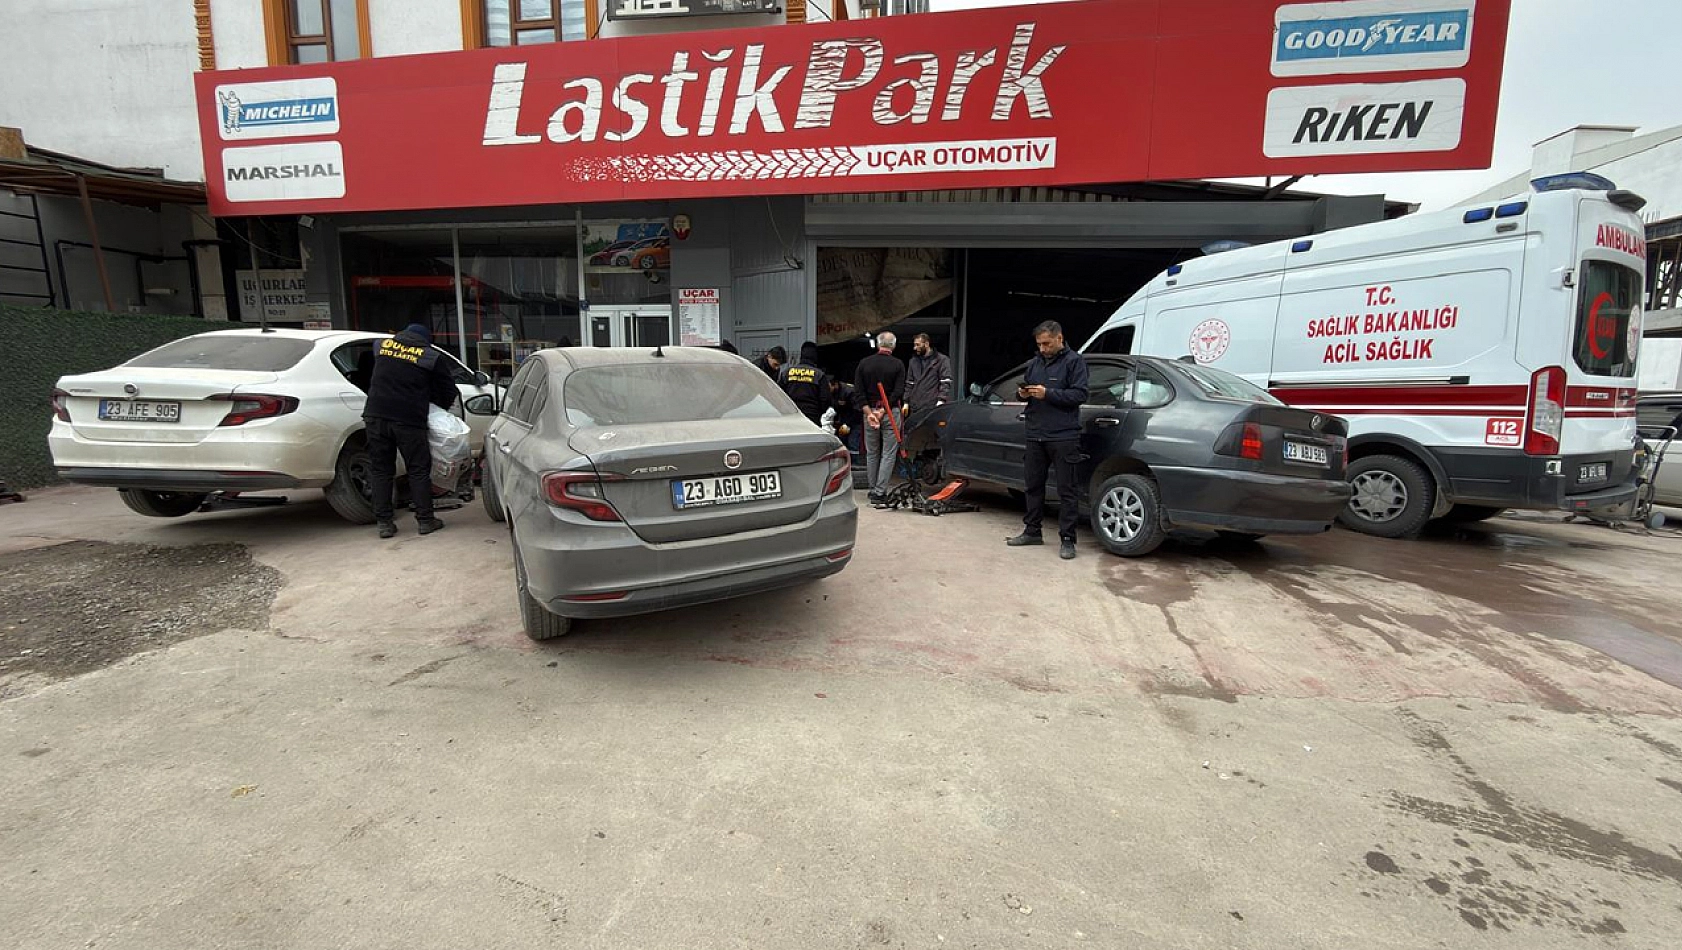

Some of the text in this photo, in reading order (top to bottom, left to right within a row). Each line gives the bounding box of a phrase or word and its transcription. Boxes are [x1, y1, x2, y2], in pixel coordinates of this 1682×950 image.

[245, 103, 331, 120] MICHELIN
[867, 140, 1050, 171] UÇAR OTOMOTİV
[227, 163, 341, 181] MARSHAL
[683, 289, 714, 298] UÇAR
[1365, 285, 1396, 306] T.C.
[1307, 305, 1459, 339] SAĞLIK BAKANLIĞI
[1322, 335, 1434, 364] ACİL SAĞLIK
[107, 403, 178, 418] 23 AFE 905
[1491, 420, 1517, 435] 112
[1289, 443, 1298, 458] 23
[684, 481, 706, 502] 23
[714, 477, 742, 498] AGD
[750, 474, 777, 494] 903
